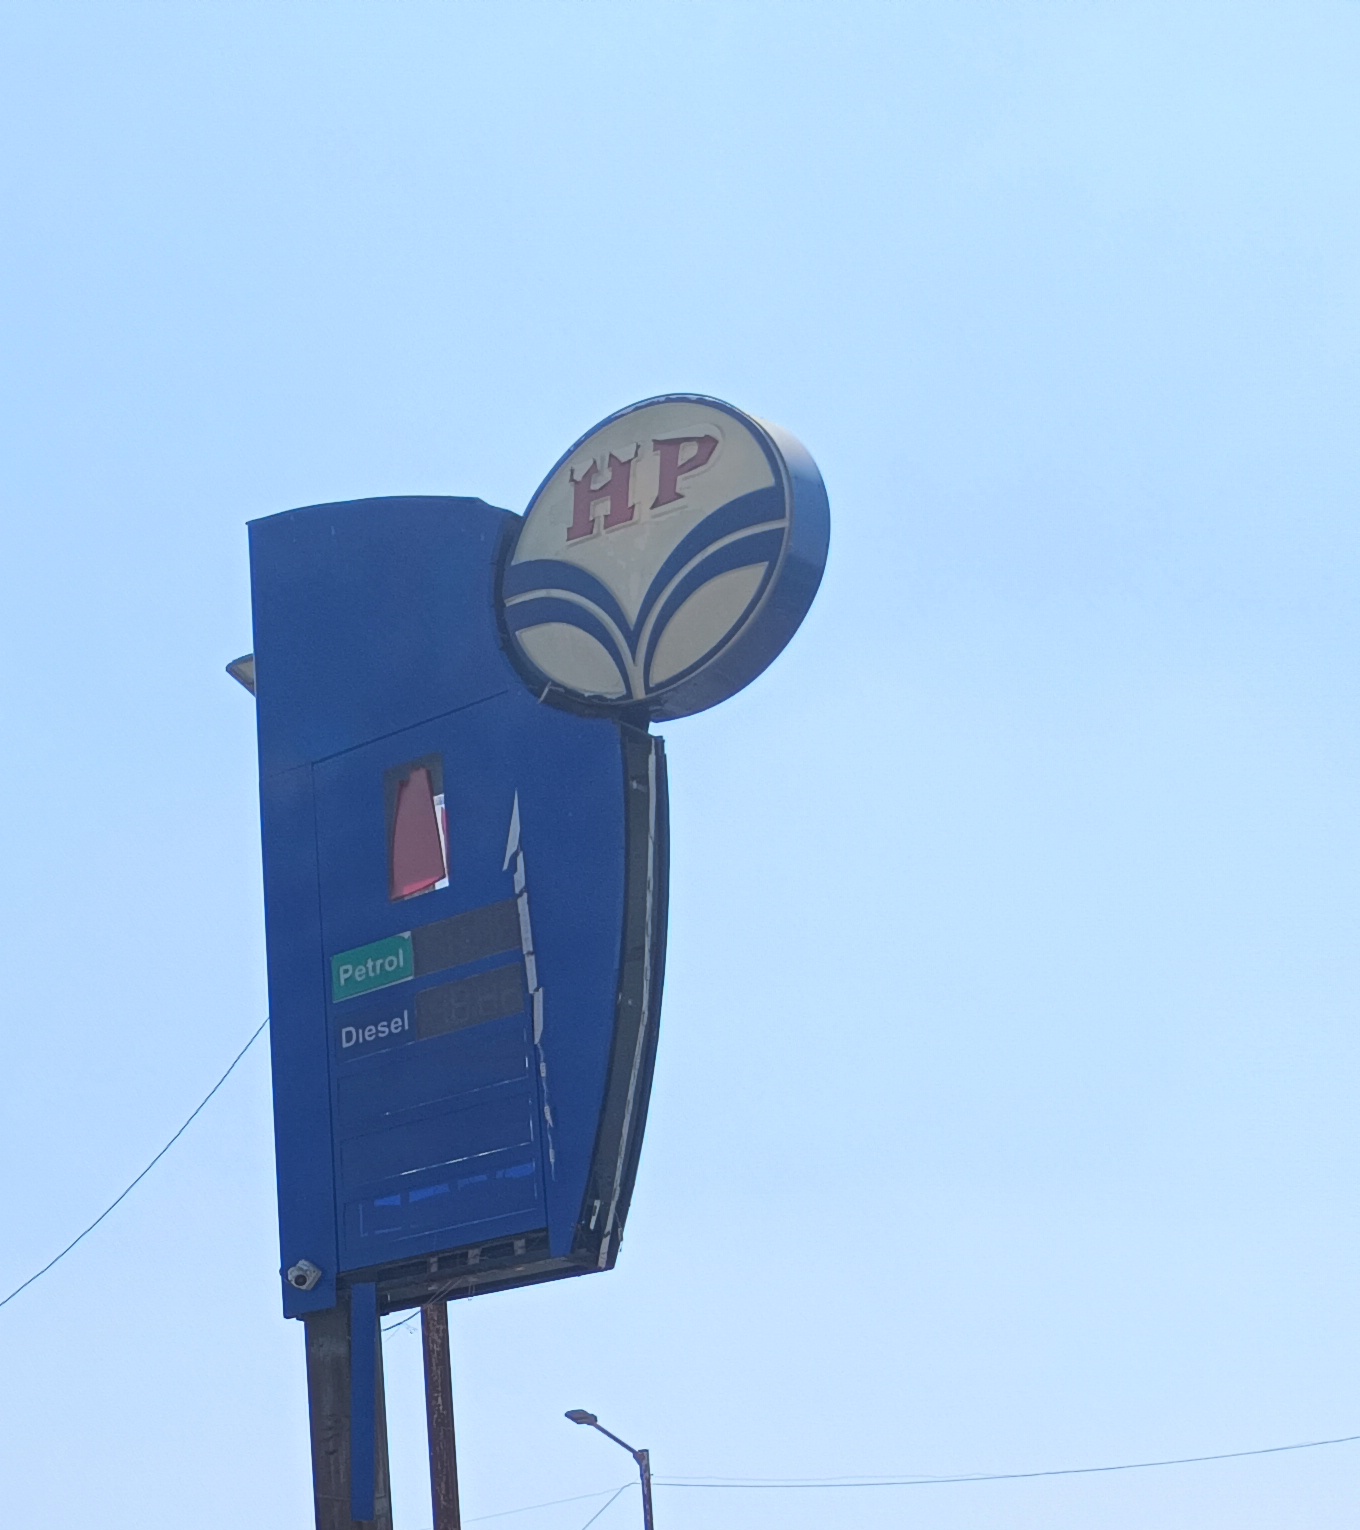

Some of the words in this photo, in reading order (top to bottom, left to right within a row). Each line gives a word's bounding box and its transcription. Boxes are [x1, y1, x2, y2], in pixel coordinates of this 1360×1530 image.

[566, 434, 719, 541] HP
[339, 948, 404, 986] Petrol
[341, 1009, 409, 1049] Diesel
